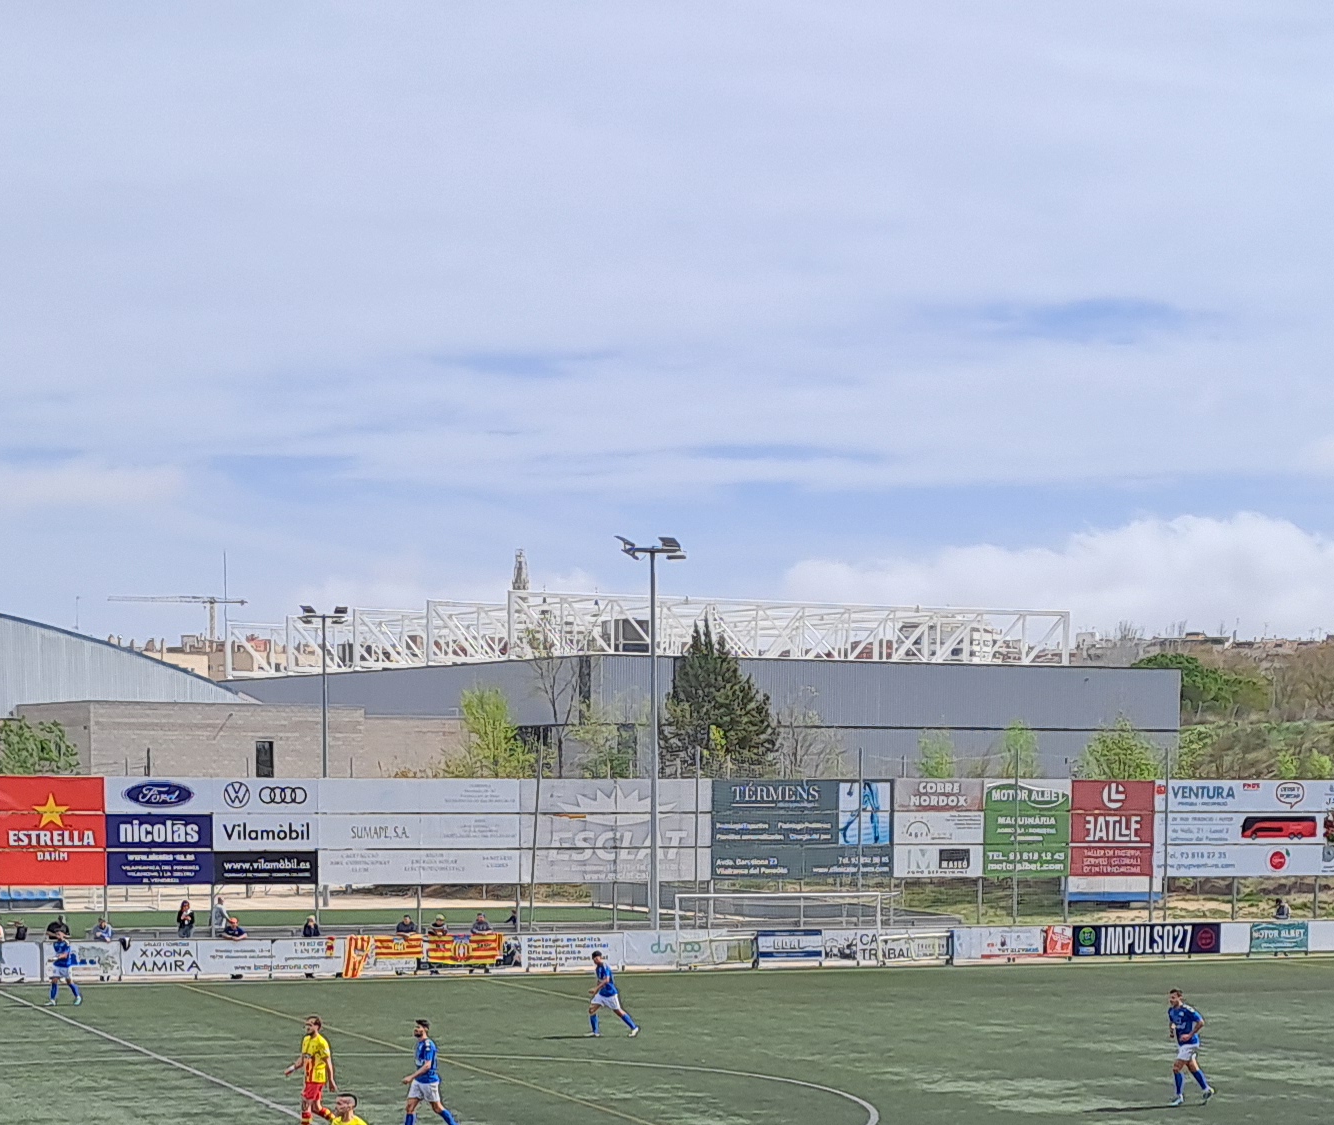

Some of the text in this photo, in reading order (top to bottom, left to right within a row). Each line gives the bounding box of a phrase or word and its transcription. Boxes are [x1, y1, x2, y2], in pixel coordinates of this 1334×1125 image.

[138, 786, 180, 802] Ford
[732, 781, 820, 800] TÉRMENS
[919, 782, 961, 793] COBRE
[1172, 786, 1236, 799] VENTURA
[8, 830, 96, 846] ESTRELLA
[223, 822, 310, 840] Vilamòbil
[1100, 925, 1192, 954] IMPULSO27
